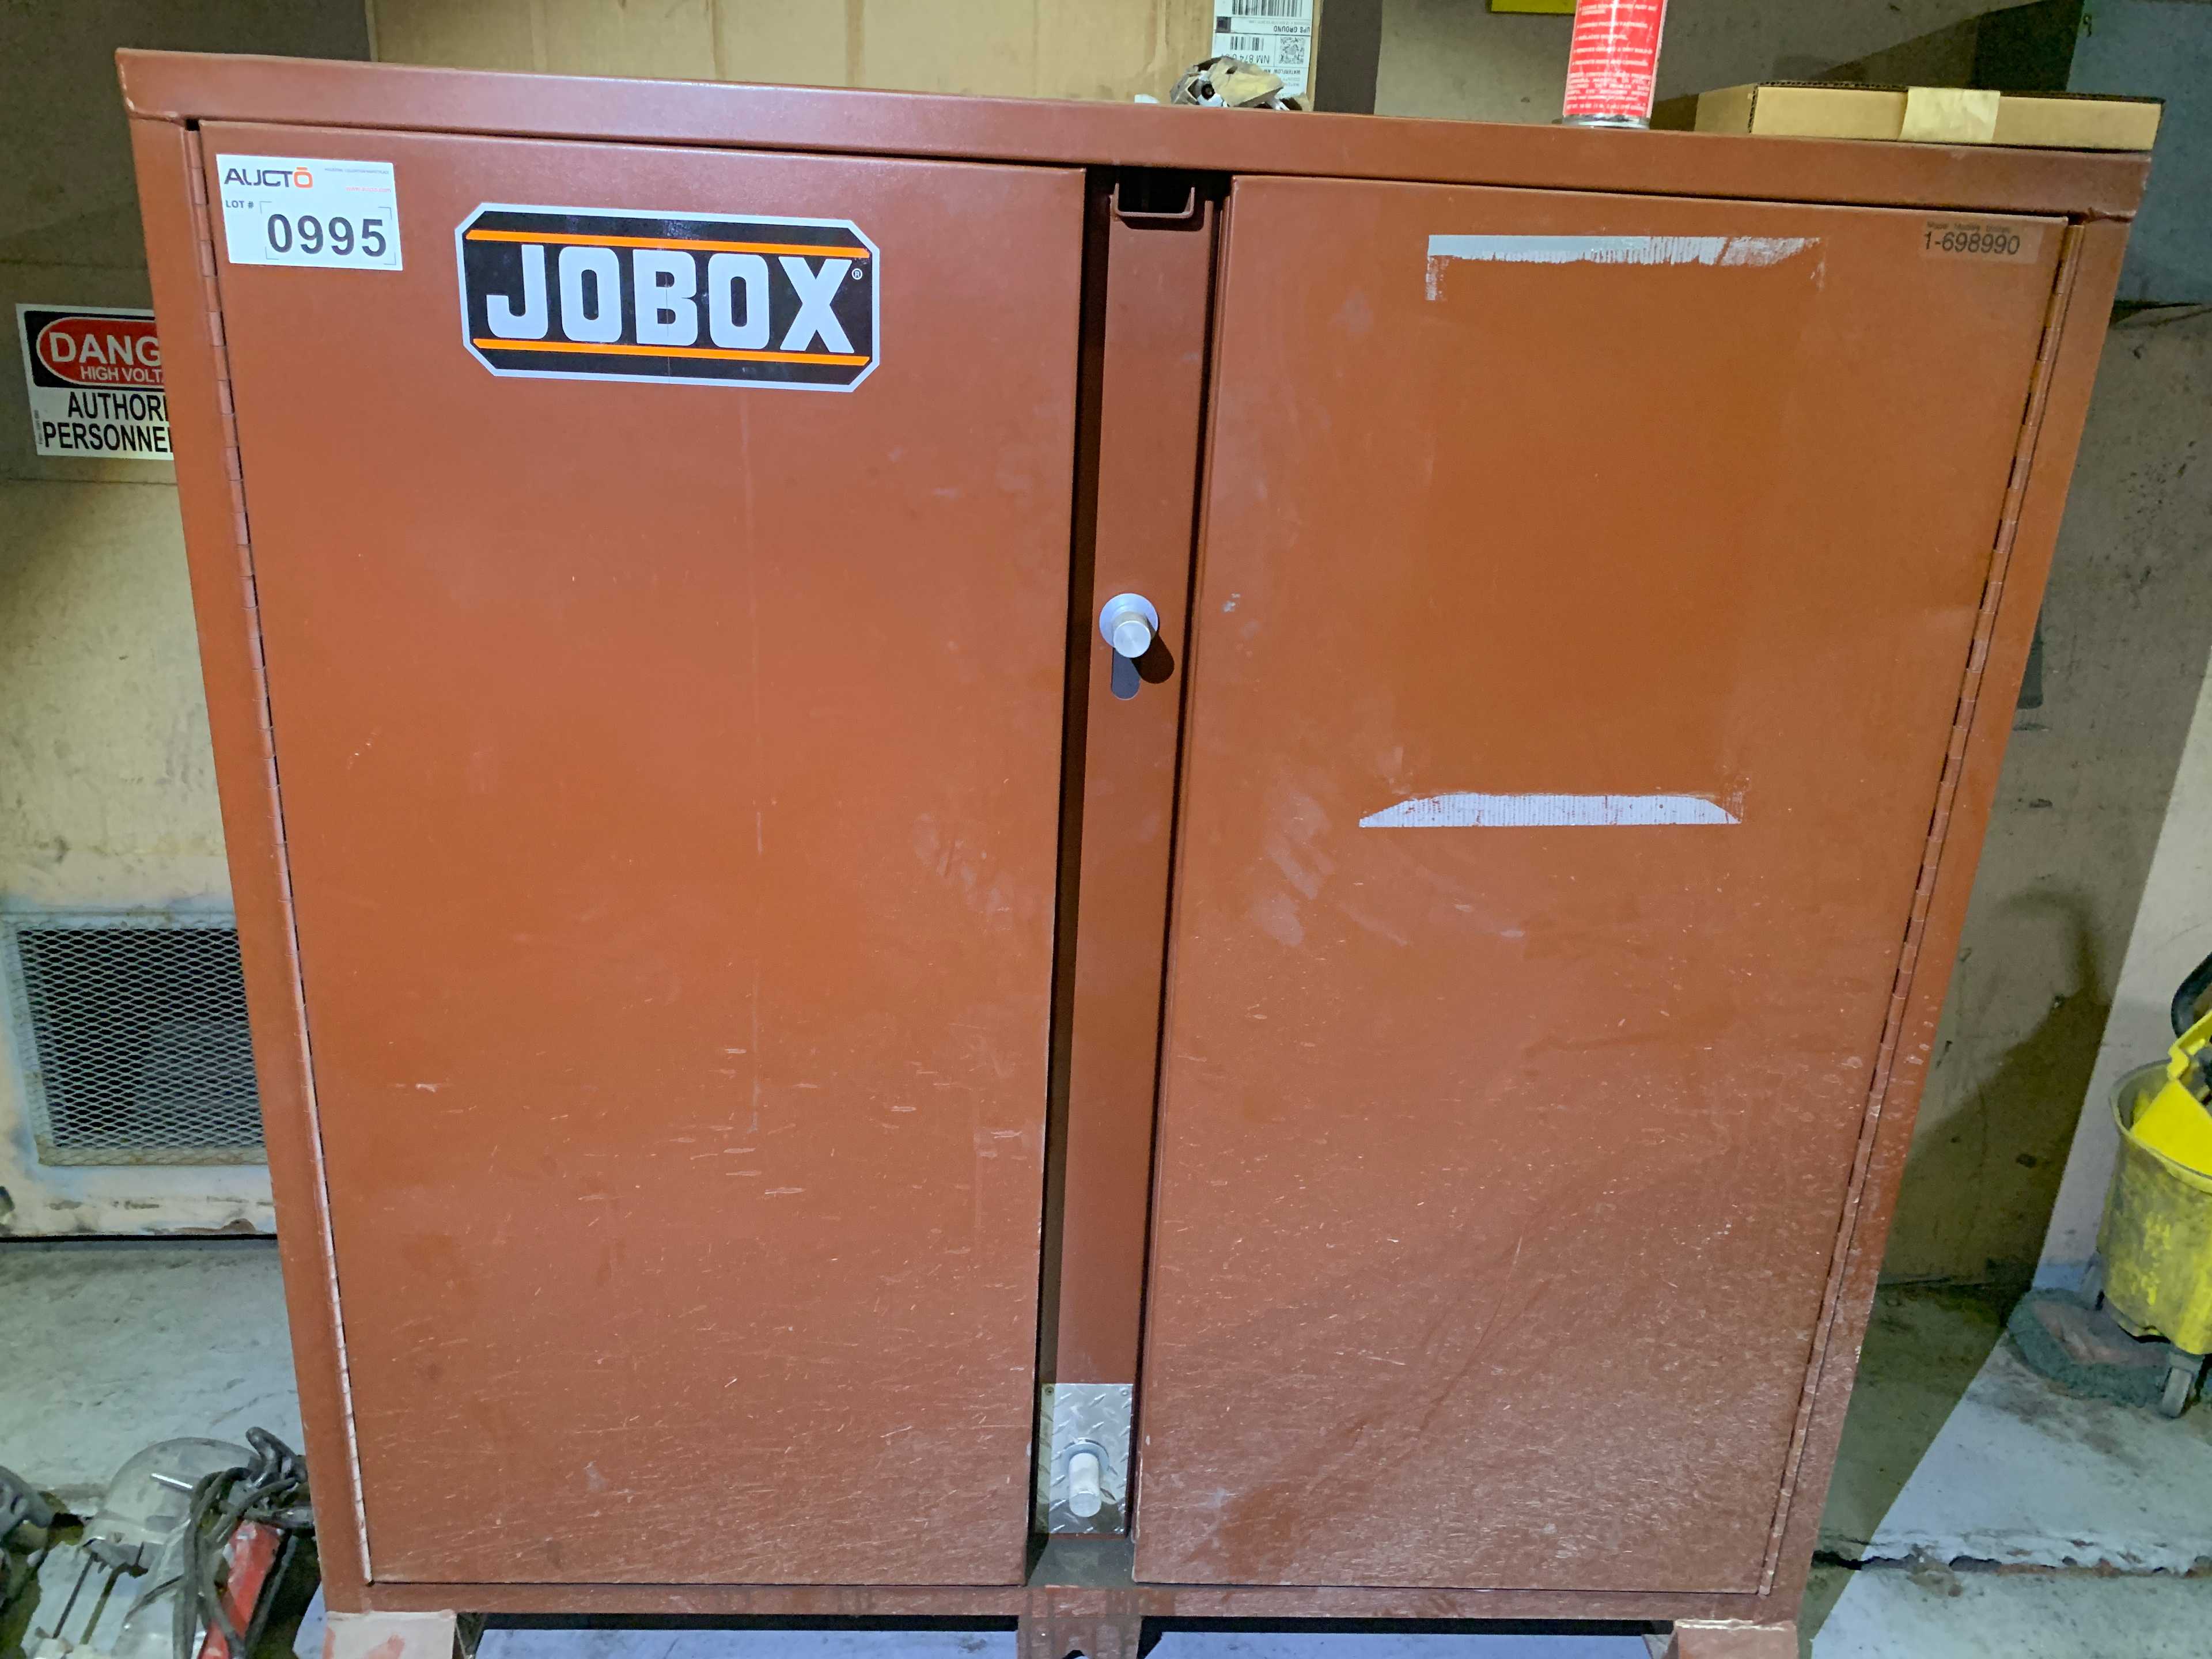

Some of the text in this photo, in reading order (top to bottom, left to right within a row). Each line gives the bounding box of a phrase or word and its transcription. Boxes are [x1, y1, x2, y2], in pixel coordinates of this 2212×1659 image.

[1257, 55, 1270, 64] NM
[225, 200, 245, 209] LOT
[267, 214, 387, 257] 0995
[1924, 231, 2021, 255] 1-698990
[49, 331, 161, 366] DANG
[80, 366, 165, 383] HIGH VOLT
